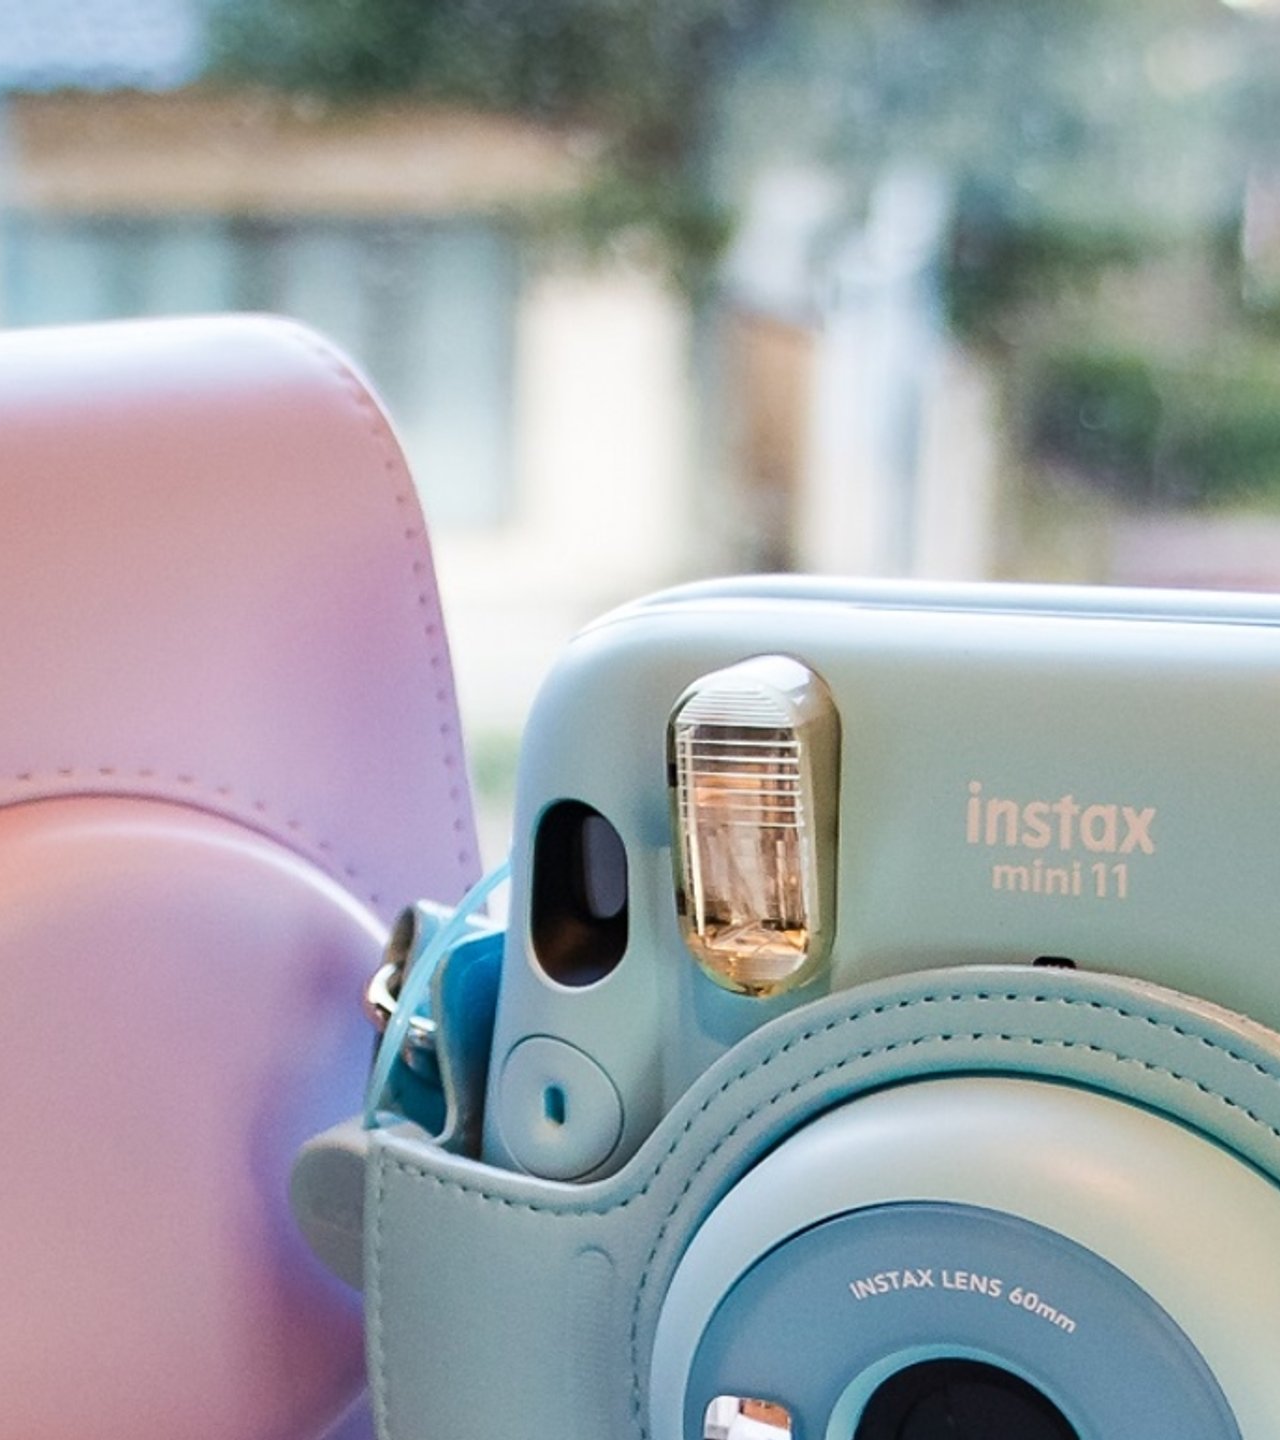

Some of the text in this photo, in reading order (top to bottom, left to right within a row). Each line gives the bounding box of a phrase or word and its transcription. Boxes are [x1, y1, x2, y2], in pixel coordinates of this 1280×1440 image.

[967, 781, 1156, 854] instax
[992, 858, 1128, 899] mini 11
[849, 1269, 1077, 1334] INSTAX LENS 60mm
